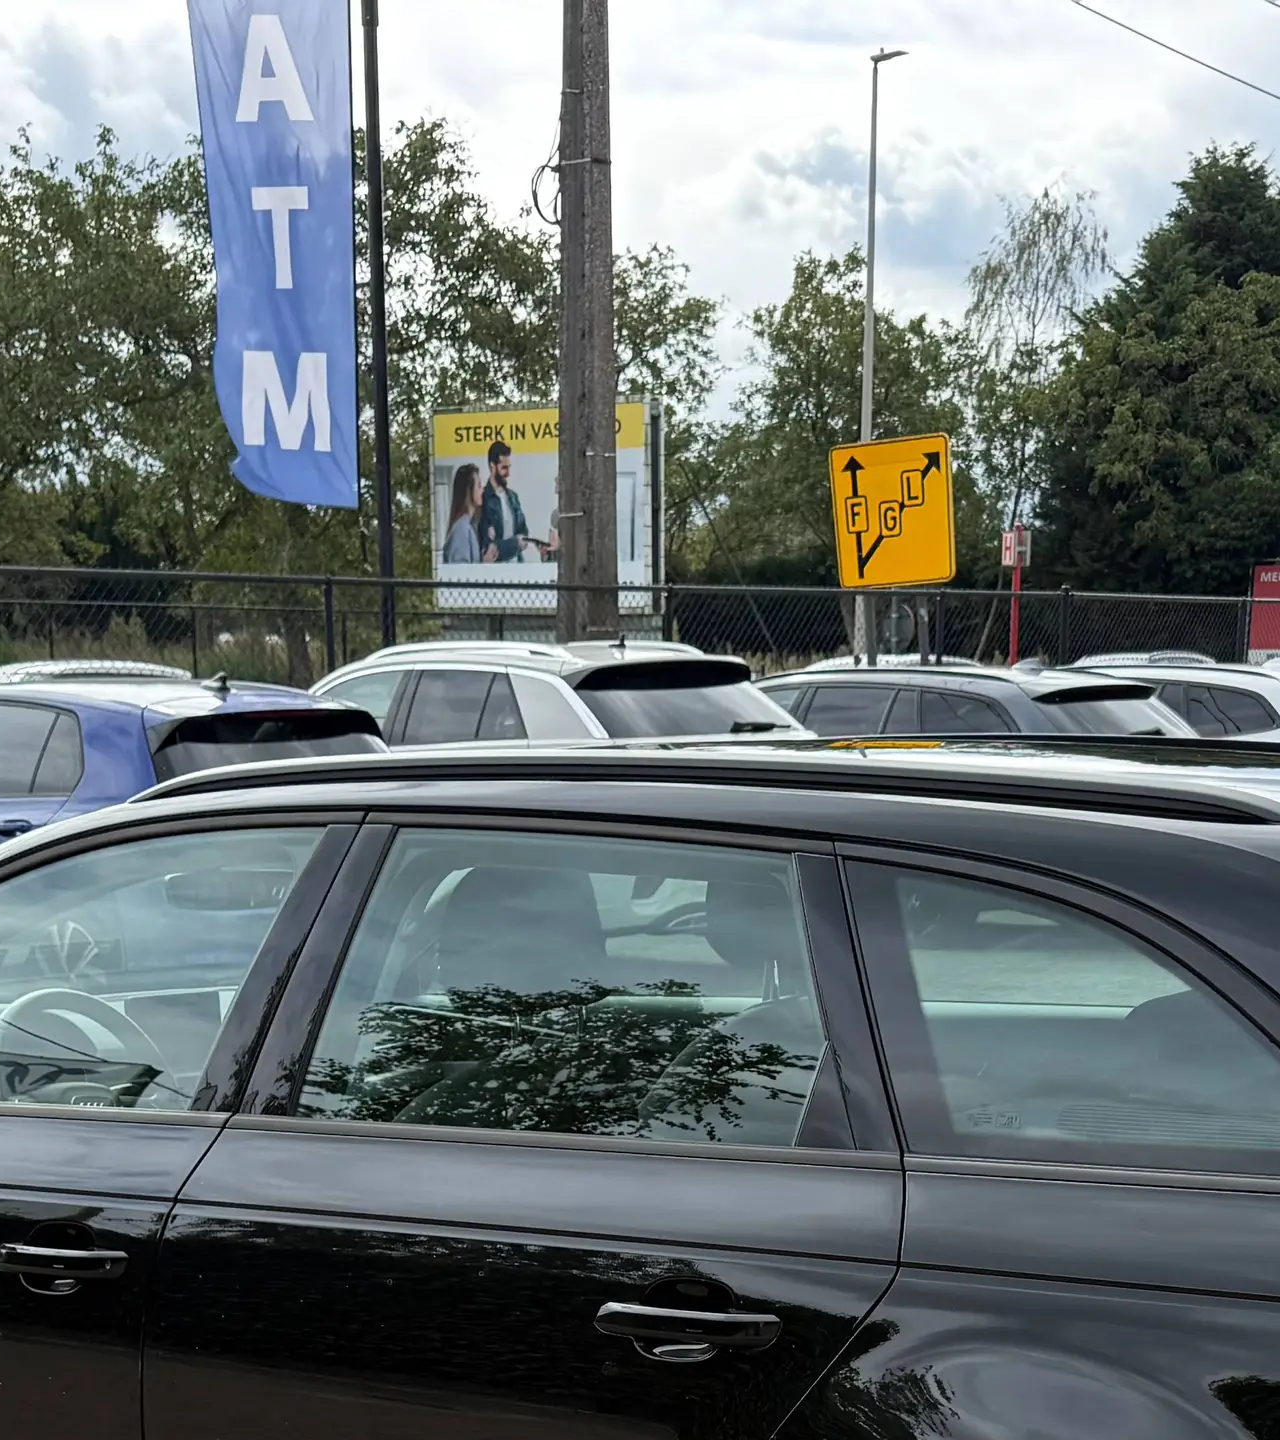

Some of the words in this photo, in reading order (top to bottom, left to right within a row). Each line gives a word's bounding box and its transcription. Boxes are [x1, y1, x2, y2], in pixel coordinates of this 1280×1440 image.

[454, 424, 504, 443] STERK
[510, 424, 526, 441] IN
[906, 476, 919, 502] L
[851, 501, 863, 528] F
[883, 506, 898, 532] G
